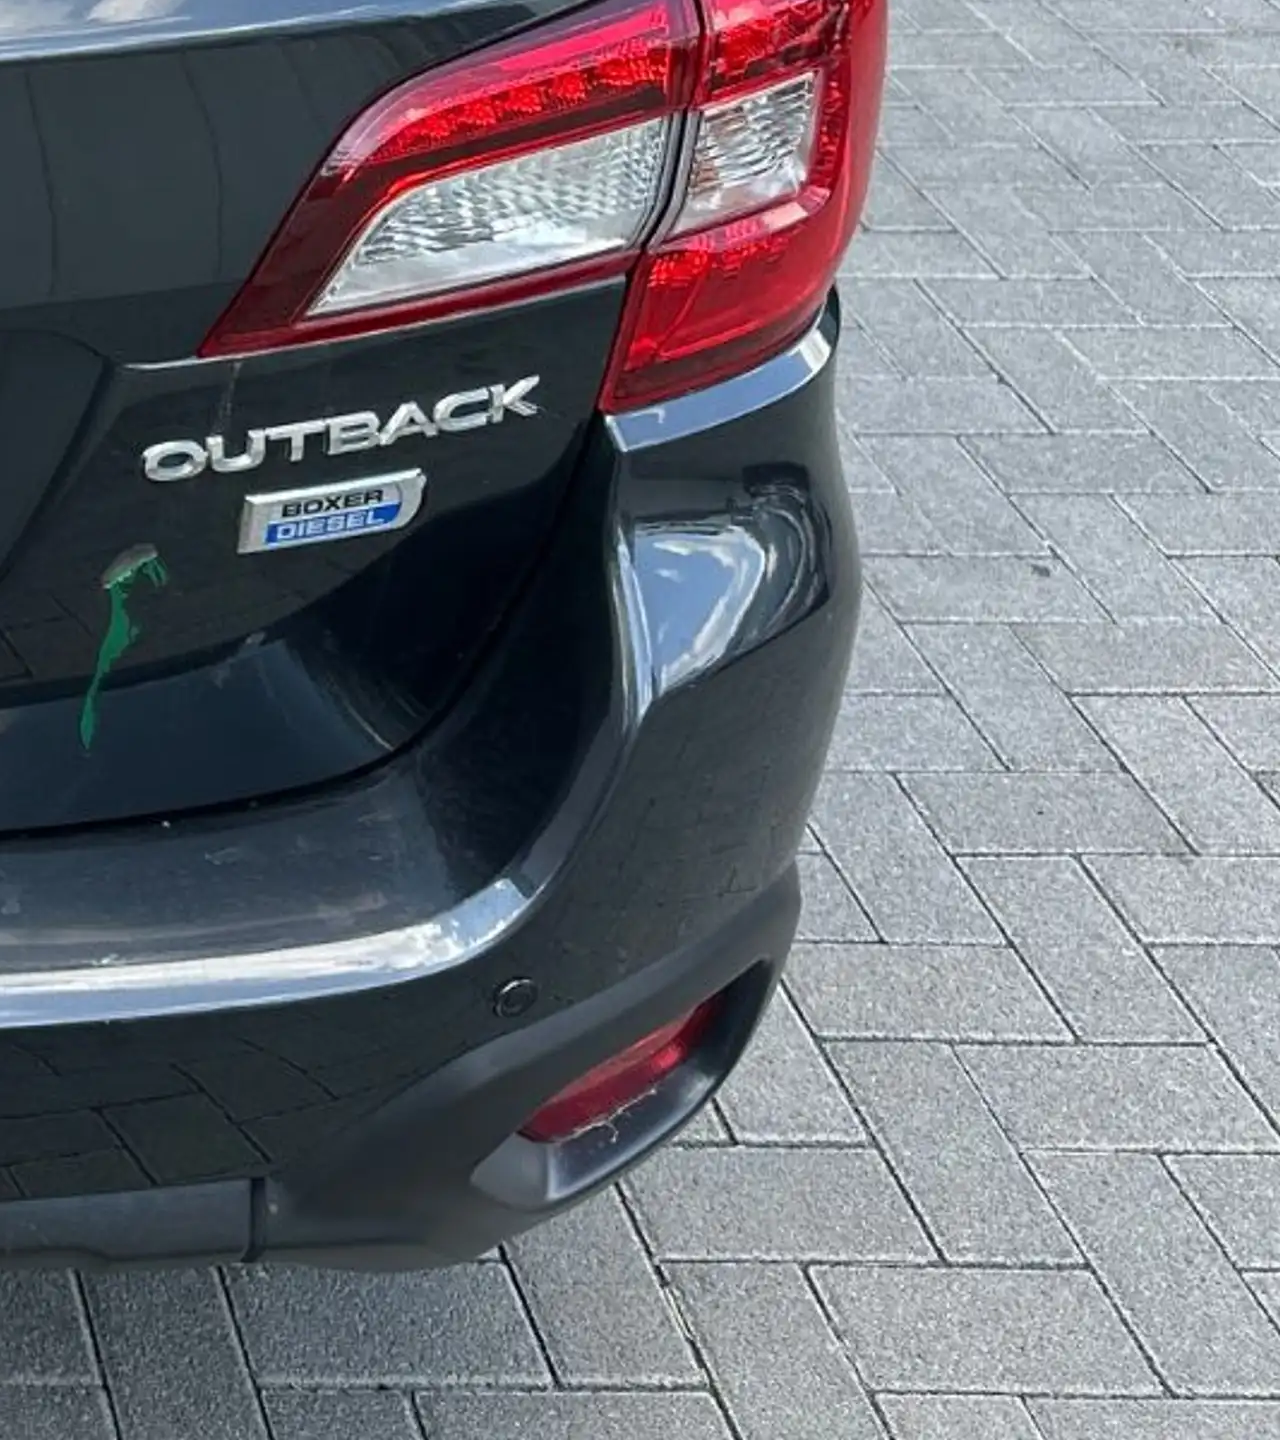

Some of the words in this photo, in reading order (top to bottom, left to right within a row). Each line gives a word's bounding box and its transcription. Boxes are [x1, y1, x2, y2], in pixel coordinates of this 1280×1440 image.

[141, 374, 540, 482] OUTBACK
[280, 488, 385, 518] BOXER
[275, 509, 386, 541] DIESEL
